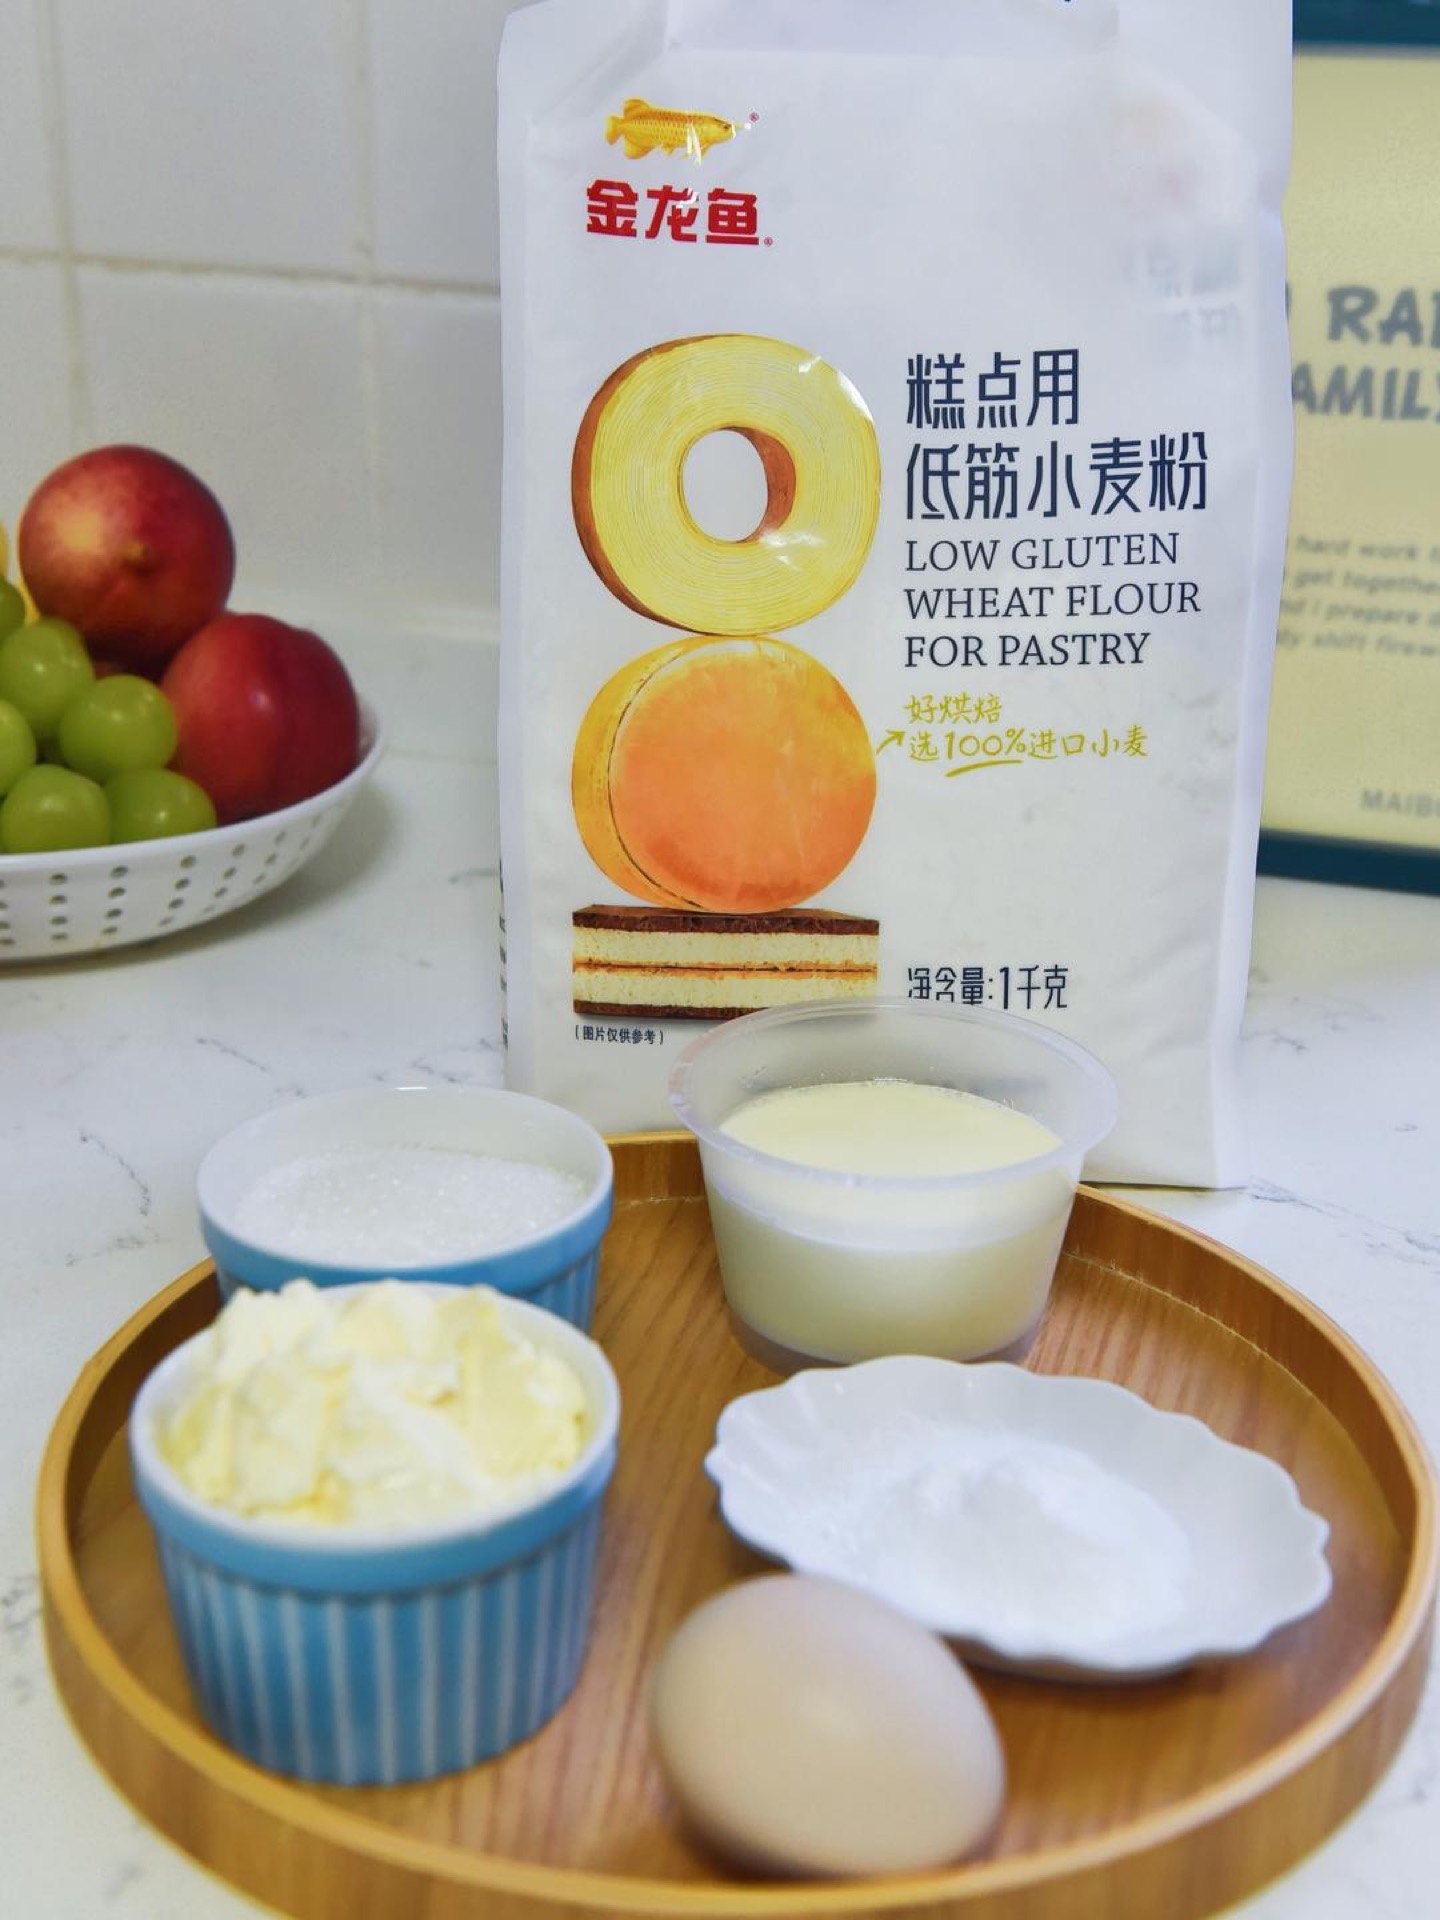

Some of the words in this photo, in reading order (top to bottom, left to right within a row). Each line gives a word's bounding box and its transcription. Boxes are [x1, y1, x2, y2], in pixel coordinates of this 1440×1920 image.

[586, 179, 760, 246] 金龙鱼
[906, 348, 1080, 430] 糕点用
[906, 431, 1208, 520] 低筋小麦粉
[905, 539, 1001, 572] LOW
[1011, 532, 1180, 570] GLUTEN
[903, 586, 1055, 619] WHEAT
[1066, 581, 1202, 617] FLOUR
[904, 635, 988, 668] FOR
[998, 632, 1152, 666] PASTRY
[904, 692, 1002, 725] 好烘焙
[909, 724, 1148, 762] 选100%进口小麦
